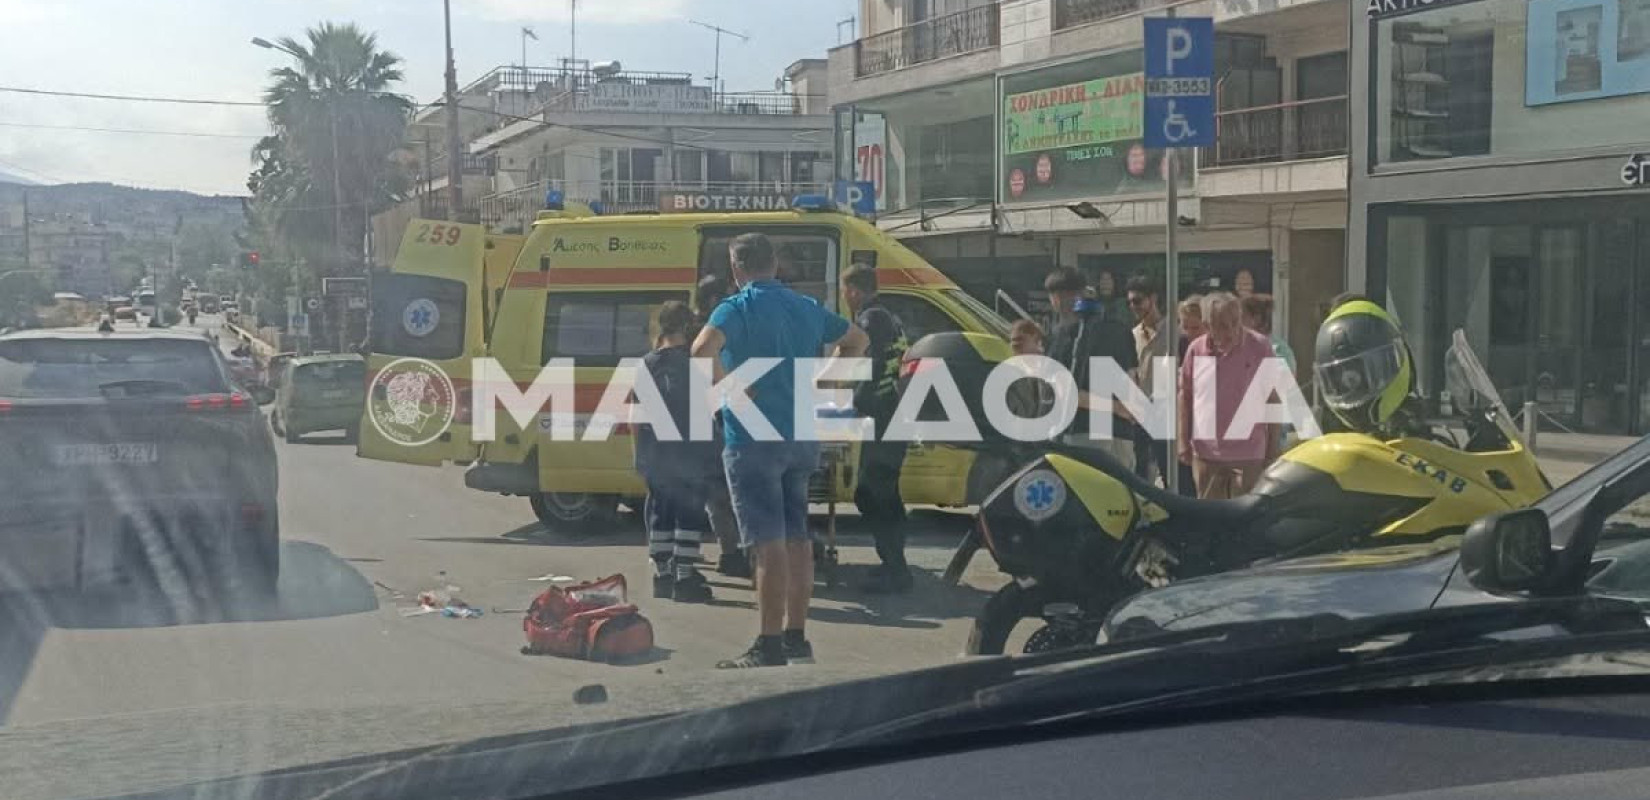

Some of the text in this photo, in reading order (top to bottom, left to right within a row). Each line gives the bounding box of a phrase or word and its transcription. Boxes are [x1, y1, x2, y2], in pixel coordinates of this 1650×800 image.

[1166, 28, 1192, 75] P
[673, 194, 789, 210] ΒΙΟΤΕΧΝΙΑ
[846, 186, 863, 205] P
[415, 224, 461, 247] 259
